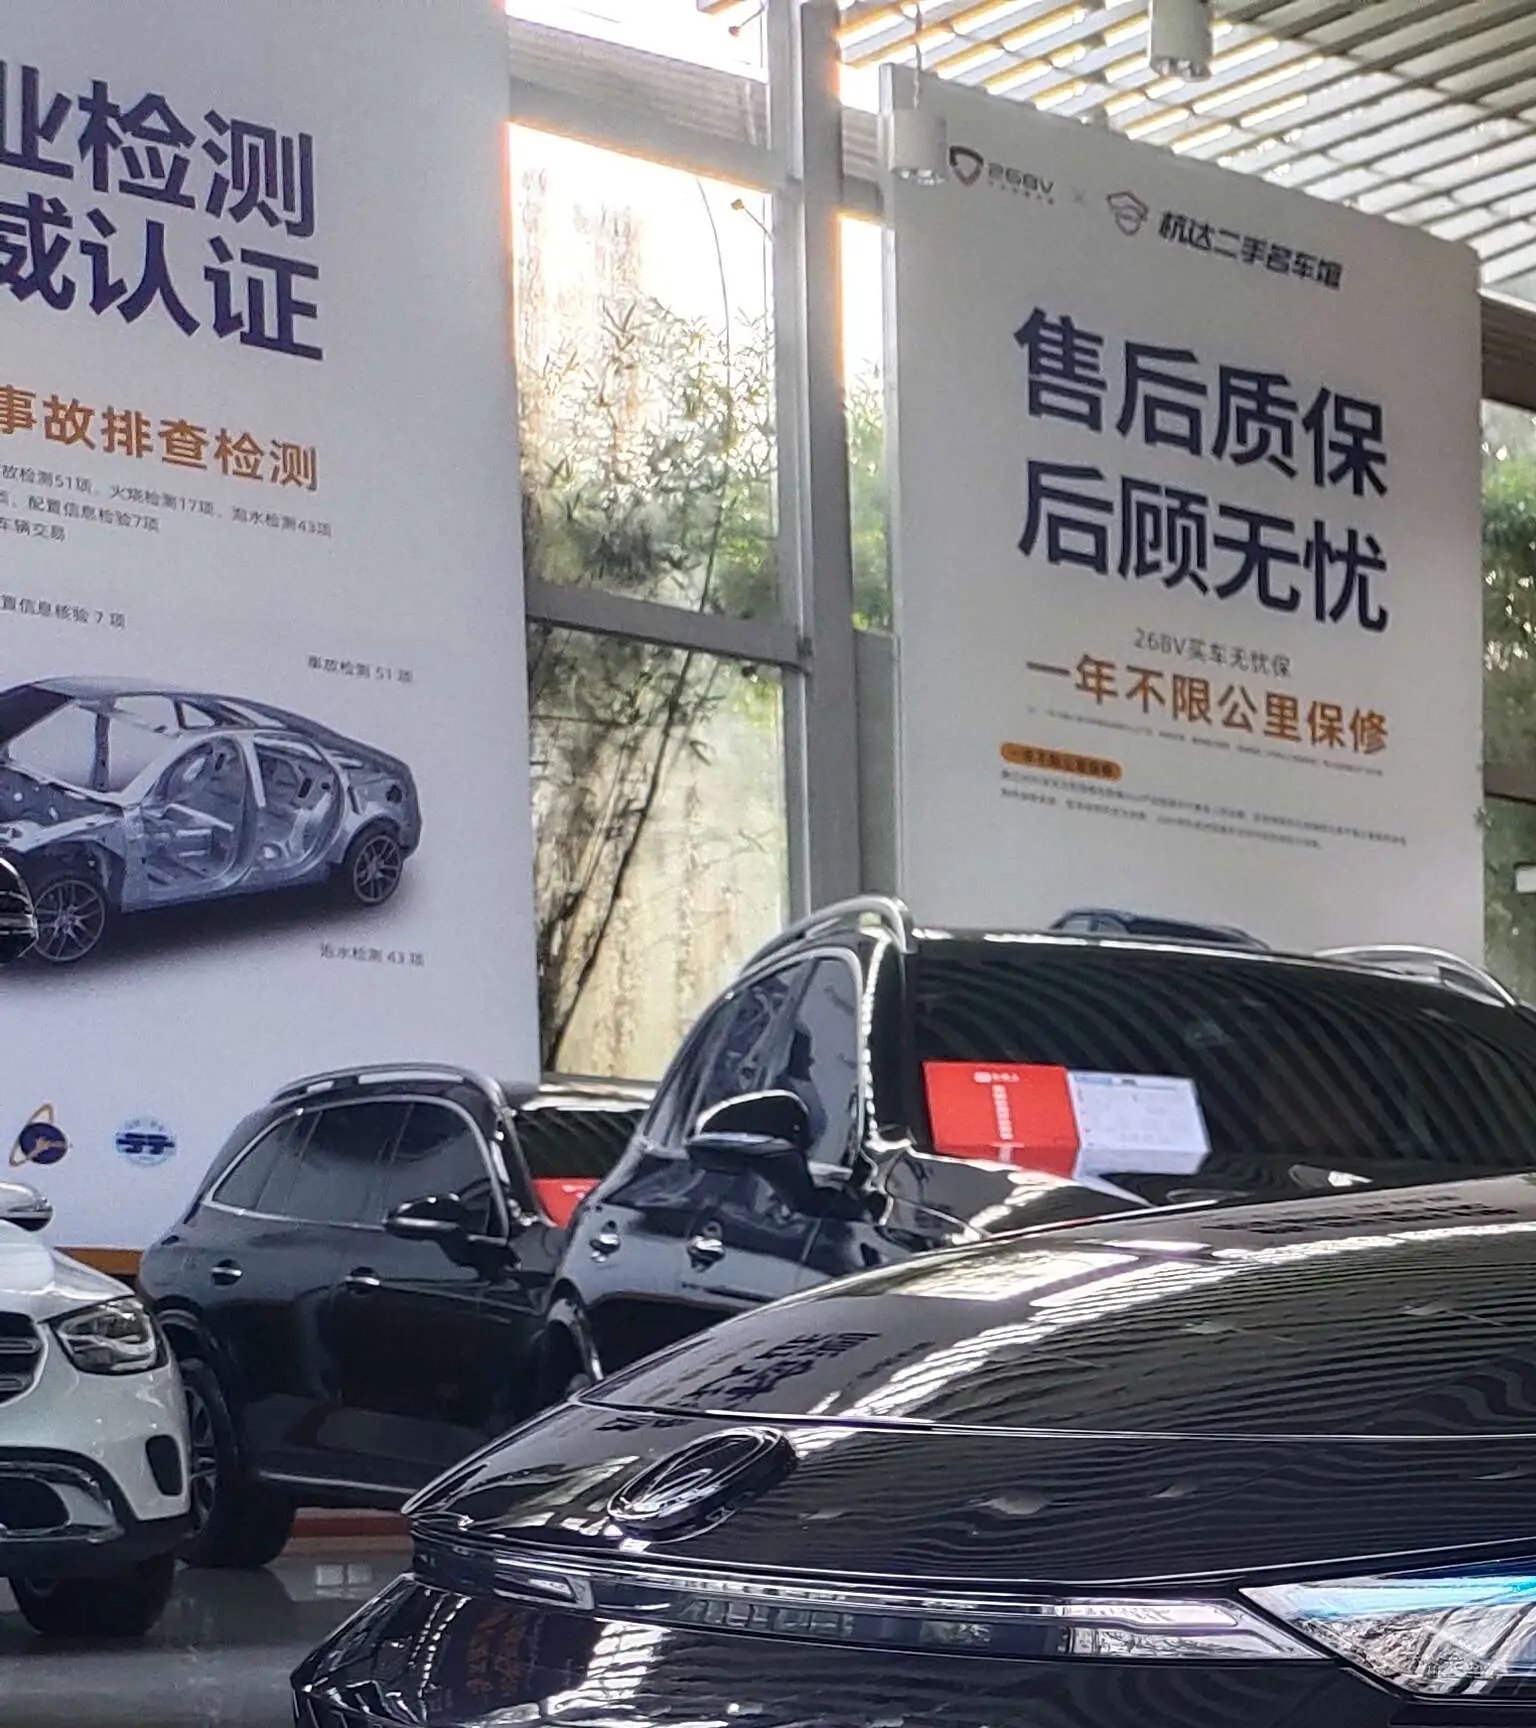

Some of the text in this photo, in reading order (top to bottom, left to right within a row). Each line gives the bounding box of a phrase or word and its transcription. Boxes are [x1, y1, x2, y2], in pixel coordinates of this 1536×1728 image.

[0, 60, 316, 237] 业检测
[1158, 209, 1343, 291] 杭达二手名车馆
[0, 384, 319, 492] 事故排查检测
[1013, 307, 1389, 497] 售后质保
[1017, 459, 1389, 633] 后顾无忧
[1026, 653, 1390, 756] 一年不限公里保修
